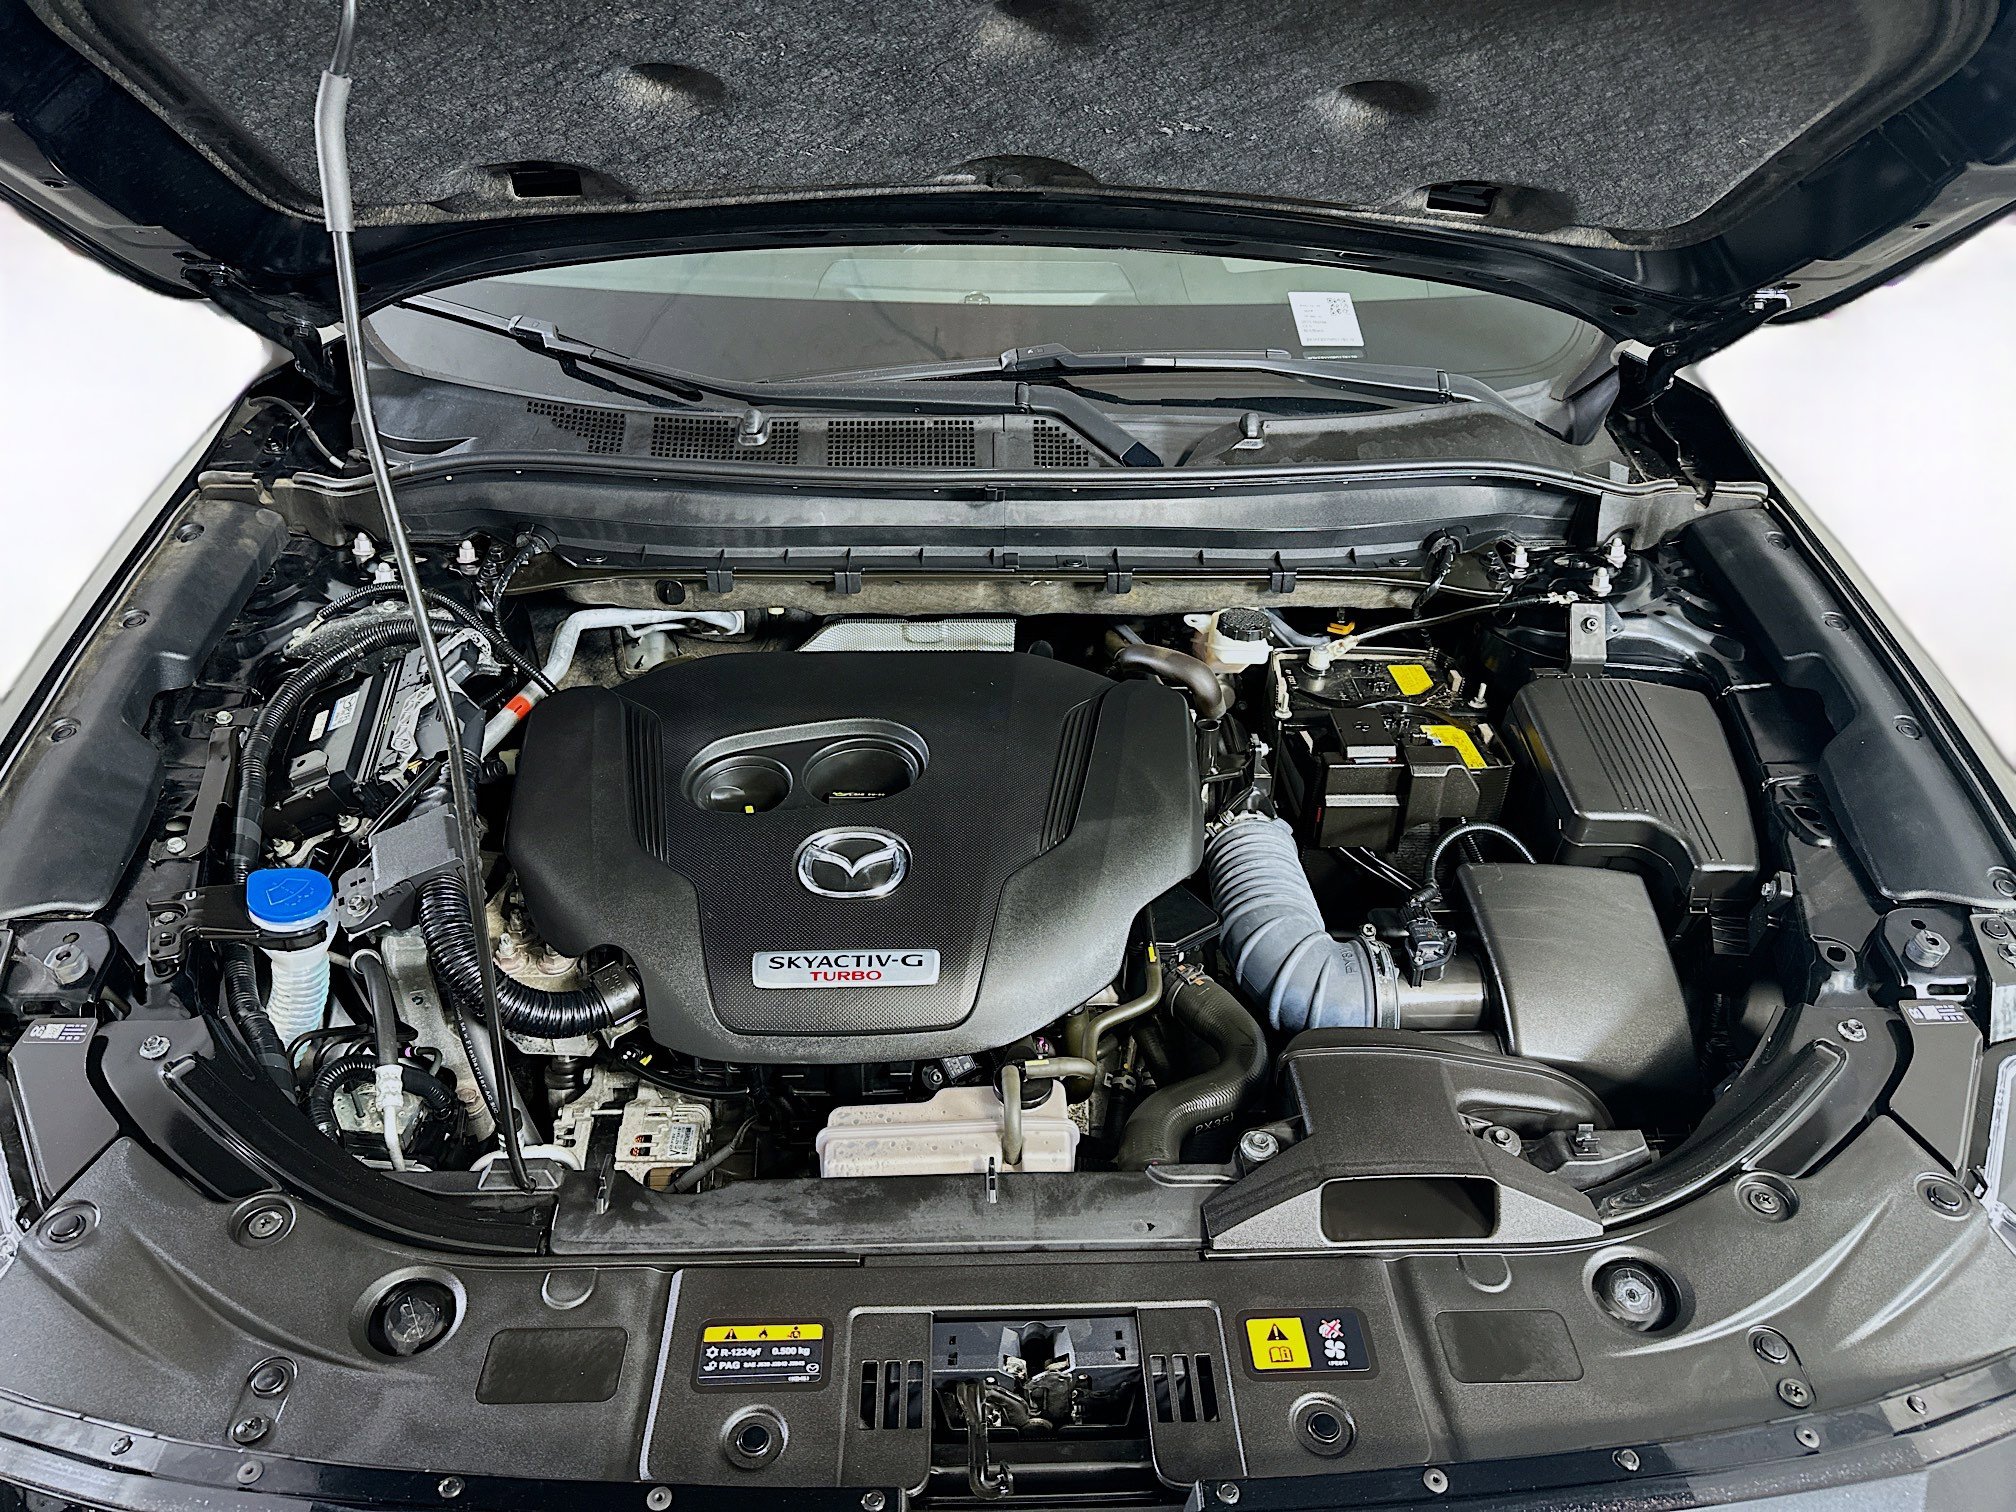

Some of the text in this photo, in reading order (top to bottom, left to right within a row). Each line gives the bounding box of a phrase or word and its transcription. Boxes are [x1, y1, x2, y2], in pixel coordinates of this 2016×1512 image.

[768, 953, 923, 969] SKYACTIV-G
[810, 970, 882, 981] TURBO
[720, 1347, 762, 1358] R-1234yf
[798, 1347, 810, 1356] kg
[719, 1361, 740, 1370] PAG
